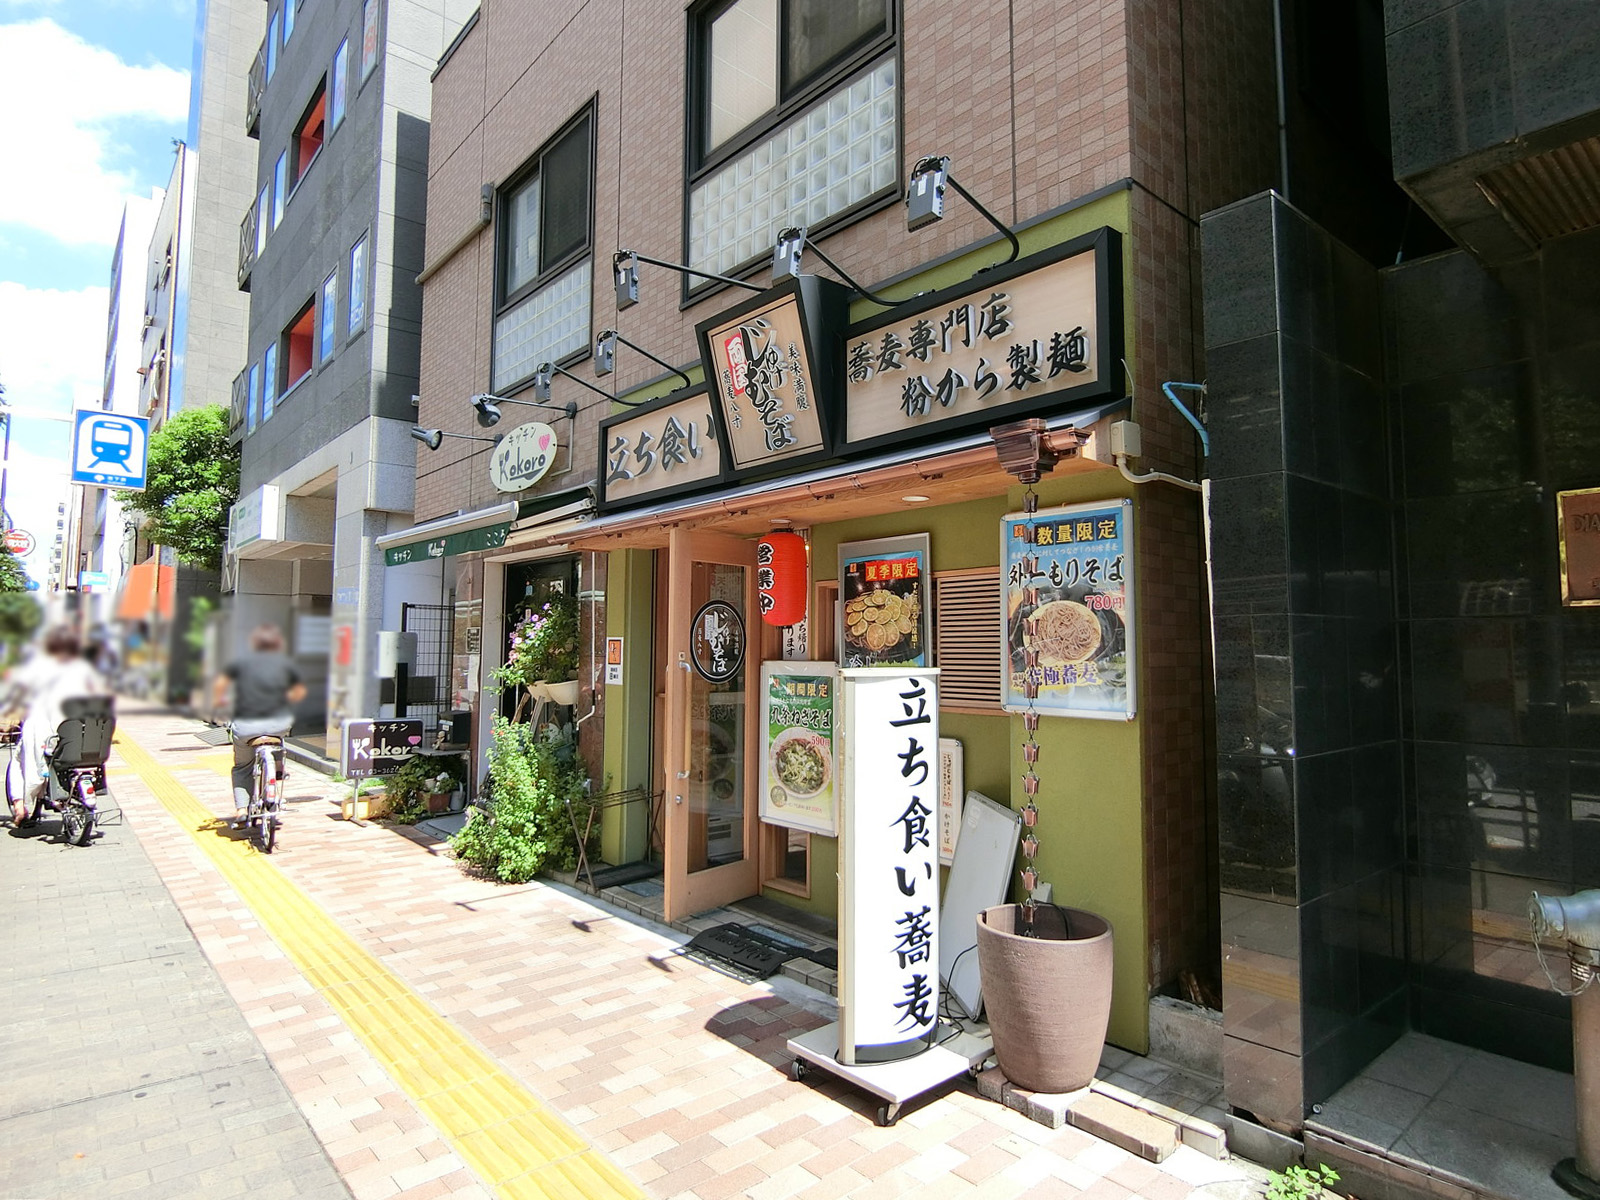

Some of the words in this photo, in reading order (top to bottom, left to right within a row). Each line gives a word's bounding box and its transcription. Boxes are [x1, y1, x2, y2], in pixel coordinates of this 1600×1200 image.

[848, 292, 1014, 384] 蕎麦専門店
[788, 342, 809, 411] 美味満腹
[900, 326, 1089, 417] 粉から製麺
[723, 369, 742, 429] 蕎麦八寸
[508, 426, 537, 447] キッチン
[606, 413, 715, 486] 立ち食い
[499, 446, 546, 484] Kokoro
[487, 529, 506, 546] こころ
[1037, 520, 1116, 546] 数量限定
[393, 550, 412, 563] キッチン
[867, 562, 918, 580] 夏季限定
[758, 543, 775, 615] 営業中
[1008, 555, 1124, 589] 外一もりそば
[1085, 595, 1122, 610] 780円
[786, 682, 828, 698] 期間限定
[367, 722, 409, 733] キッチン
[770, 705, 832, 728] 九条ねぎそば
[888, 677, 935, 1034] 立ち食い蕎麦
